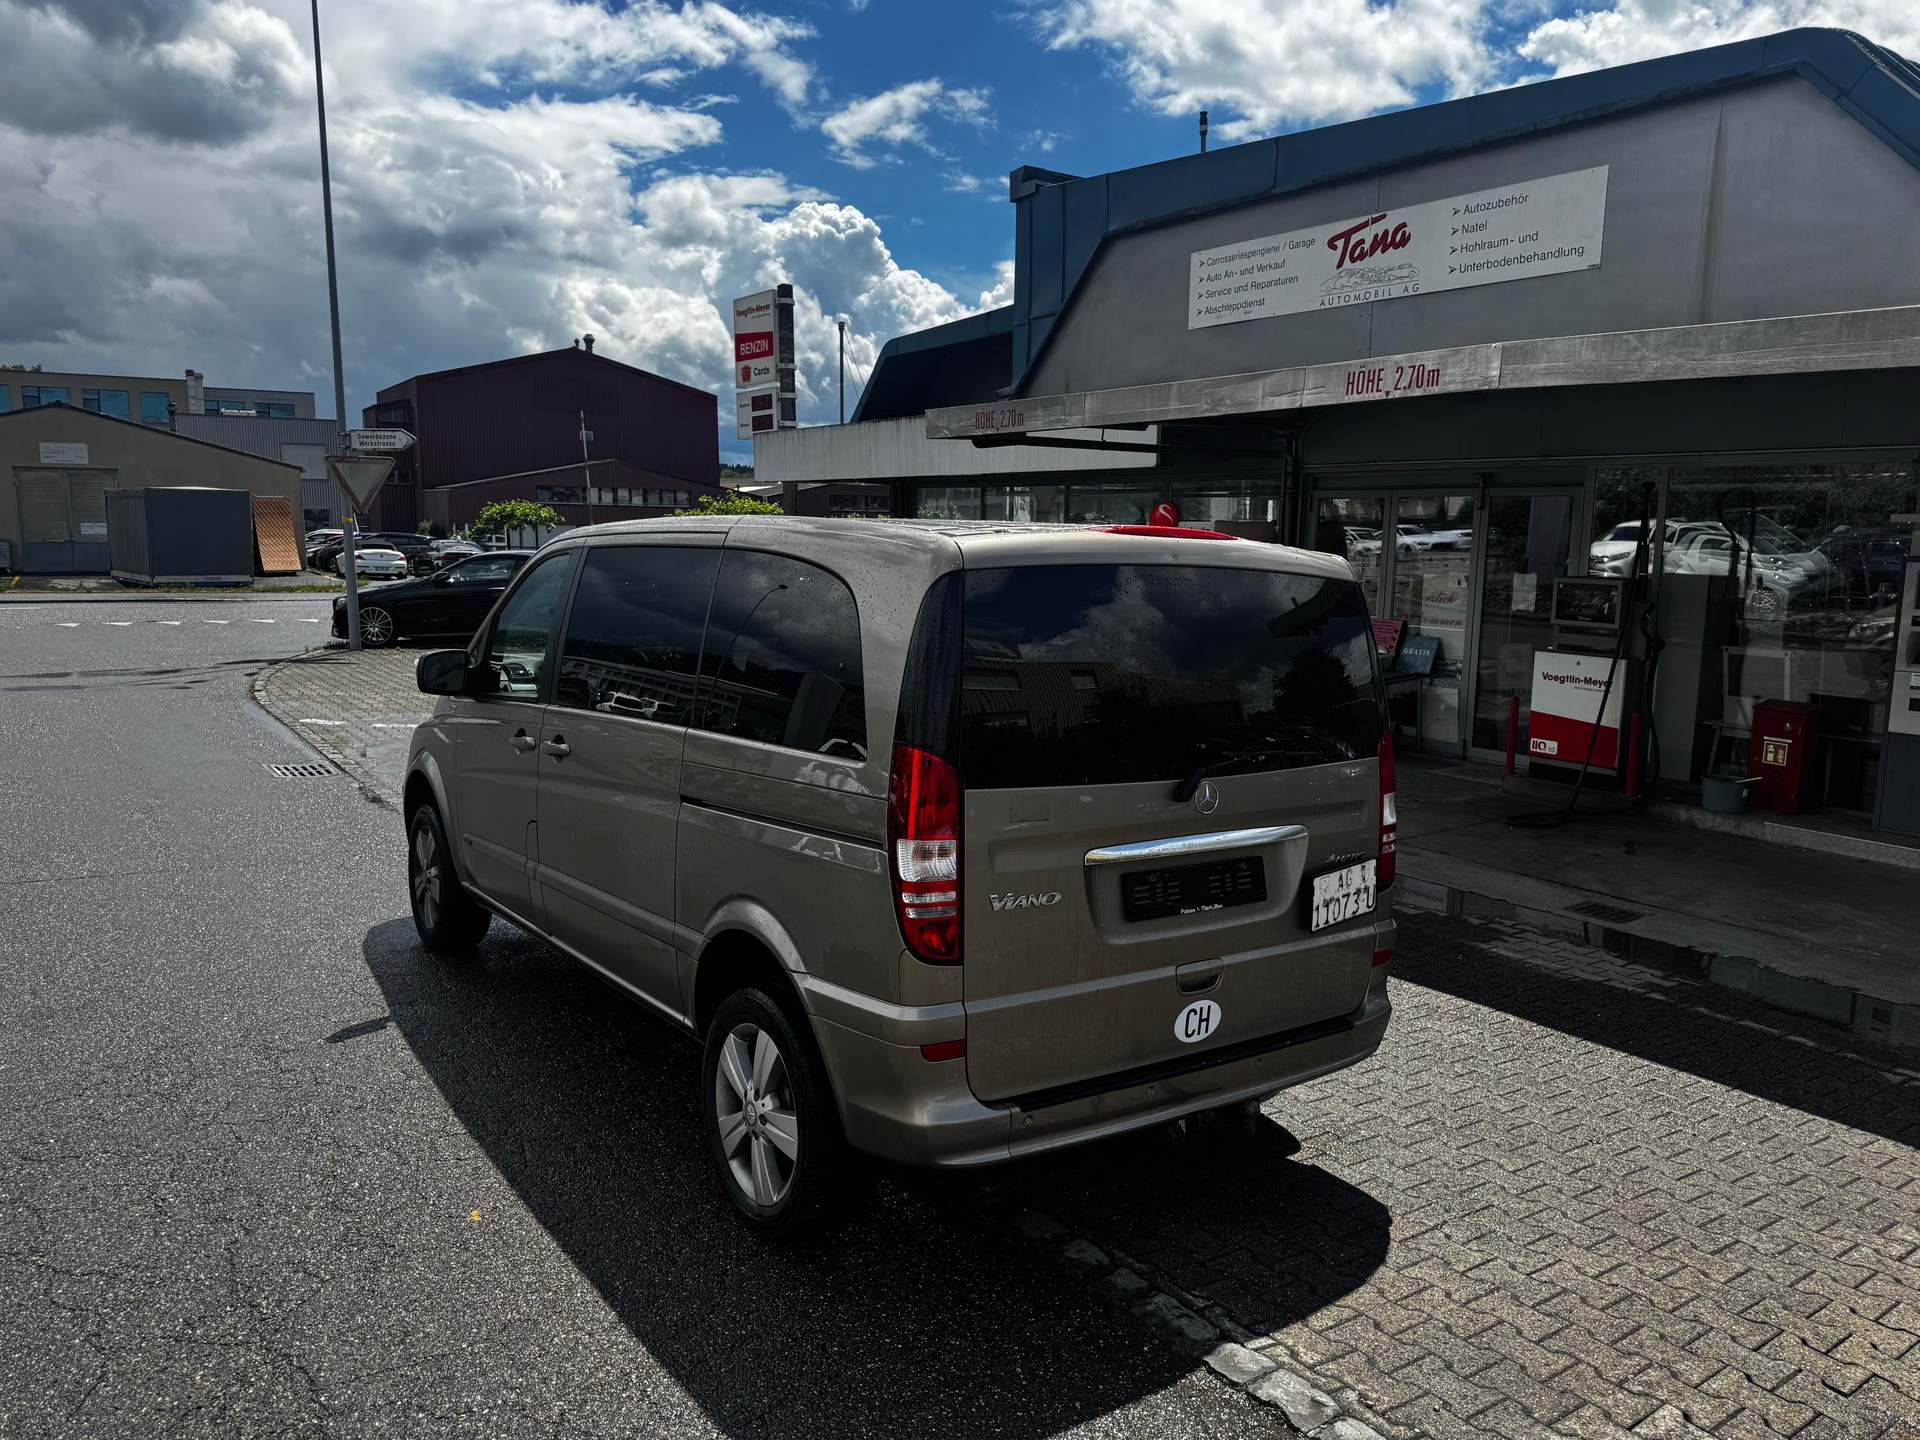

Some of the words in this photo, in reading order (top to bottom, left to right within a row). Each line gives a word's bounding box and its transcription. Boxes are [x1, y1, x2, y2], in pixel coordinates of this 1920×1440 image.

[1463, 193, 1530, 215] Autozubehör
[1461, 220, 1488, 235] Natel
[1327, 213, 1412, 269] Tana
[1460, 238, 1515, 254] Hohlraum-
[1518, 230, 1539, 244] und
[1206, 245, 1281, 268] Carrosseriespenglerei
[1288, 238, 1316, 250] Garage
[1459, 246, 1585, 274] Unterbodenbehandlung
[1206, 272, 1223, 283] Auto
[1223, 270, 1238, 280] An-
[1239, 265, 1255, 276] und
[1256, 259, 1287, 273] Verkauf
[1205, 287, 1232, 299] Service
[1234, 283, 1249, 294] und
[1250, 275, 1299, 292] Reparaturen
[1320, 287, 1392, 307] AUTOMOBIL
[1403, 283, 1420, 295] AG
[1204, 297, 1266, 315] Abschleppdienst
[740, 338, 769, 355] BENZIN
[754, 366, 770, 376] Cards
[1346, 365, 1385, 396] HÖHE
[975, 408, 996, 430] HÖHE
[357, 433, 396, 441] Gewerbezone
[358, 440, 396, 448] Werkstrasse
[1602, 602, 1610, 615] 1
[1403, 647, 1431, 656] GRATIS
[1542, 671, 1613, 688] Voegtlin-Meye
[1338, 867, 1353, 890] AG
[989, 891, 1062, 912] VIANO
[1185, 1005, 1212, 1038] CH
